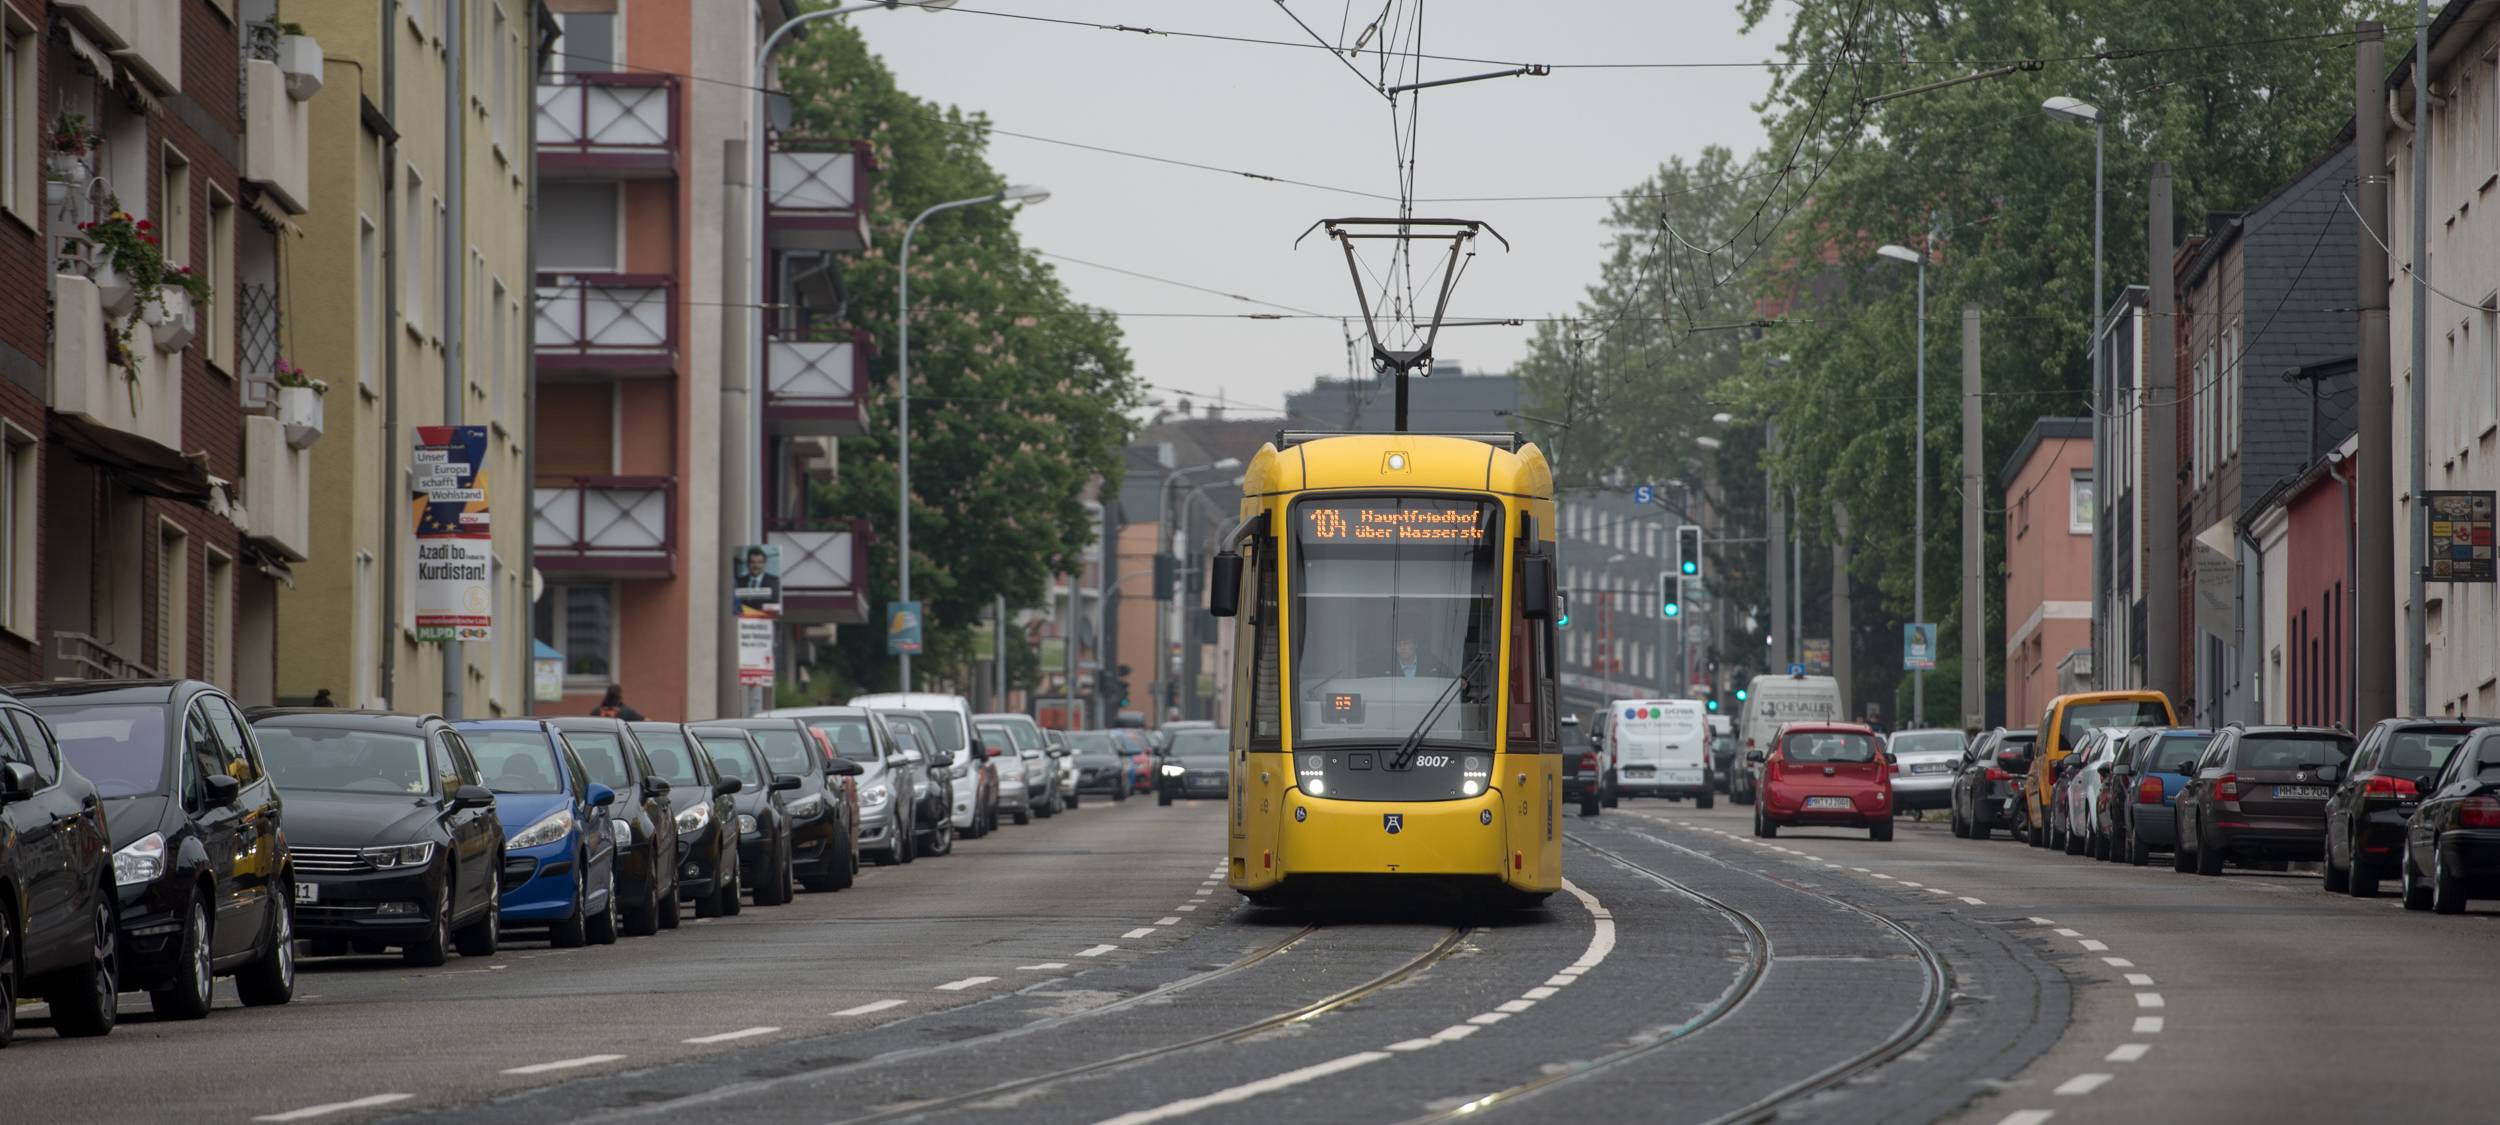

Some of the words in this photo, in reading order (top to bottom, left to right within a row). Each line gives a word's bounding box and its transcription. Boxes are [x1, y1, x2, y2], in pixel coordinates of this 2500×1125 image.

[417, 454, 445, 462] Unser
[434, 465, 468, 475] Europa
[421, 479, 454, 487] schafft
[432, 490, 482, 500] Wohlstand
[1638, 486, 1650, 502] S
[1310, 509, 1347, 538] 104
[1361, 510, 1480, 525] Hauptfriedhof
[1355, 525, 1393, 538] über
[1399, 525, 1485, 538] Wasserstr
[419, 544, 449, 560] Azadi
[451, 544, 466, 560] bo
[419, 562, 485, 581] Kurdistan!
[420, 627, 454, 638] MLPD
[1416, 755, 1449, 768] 8007
